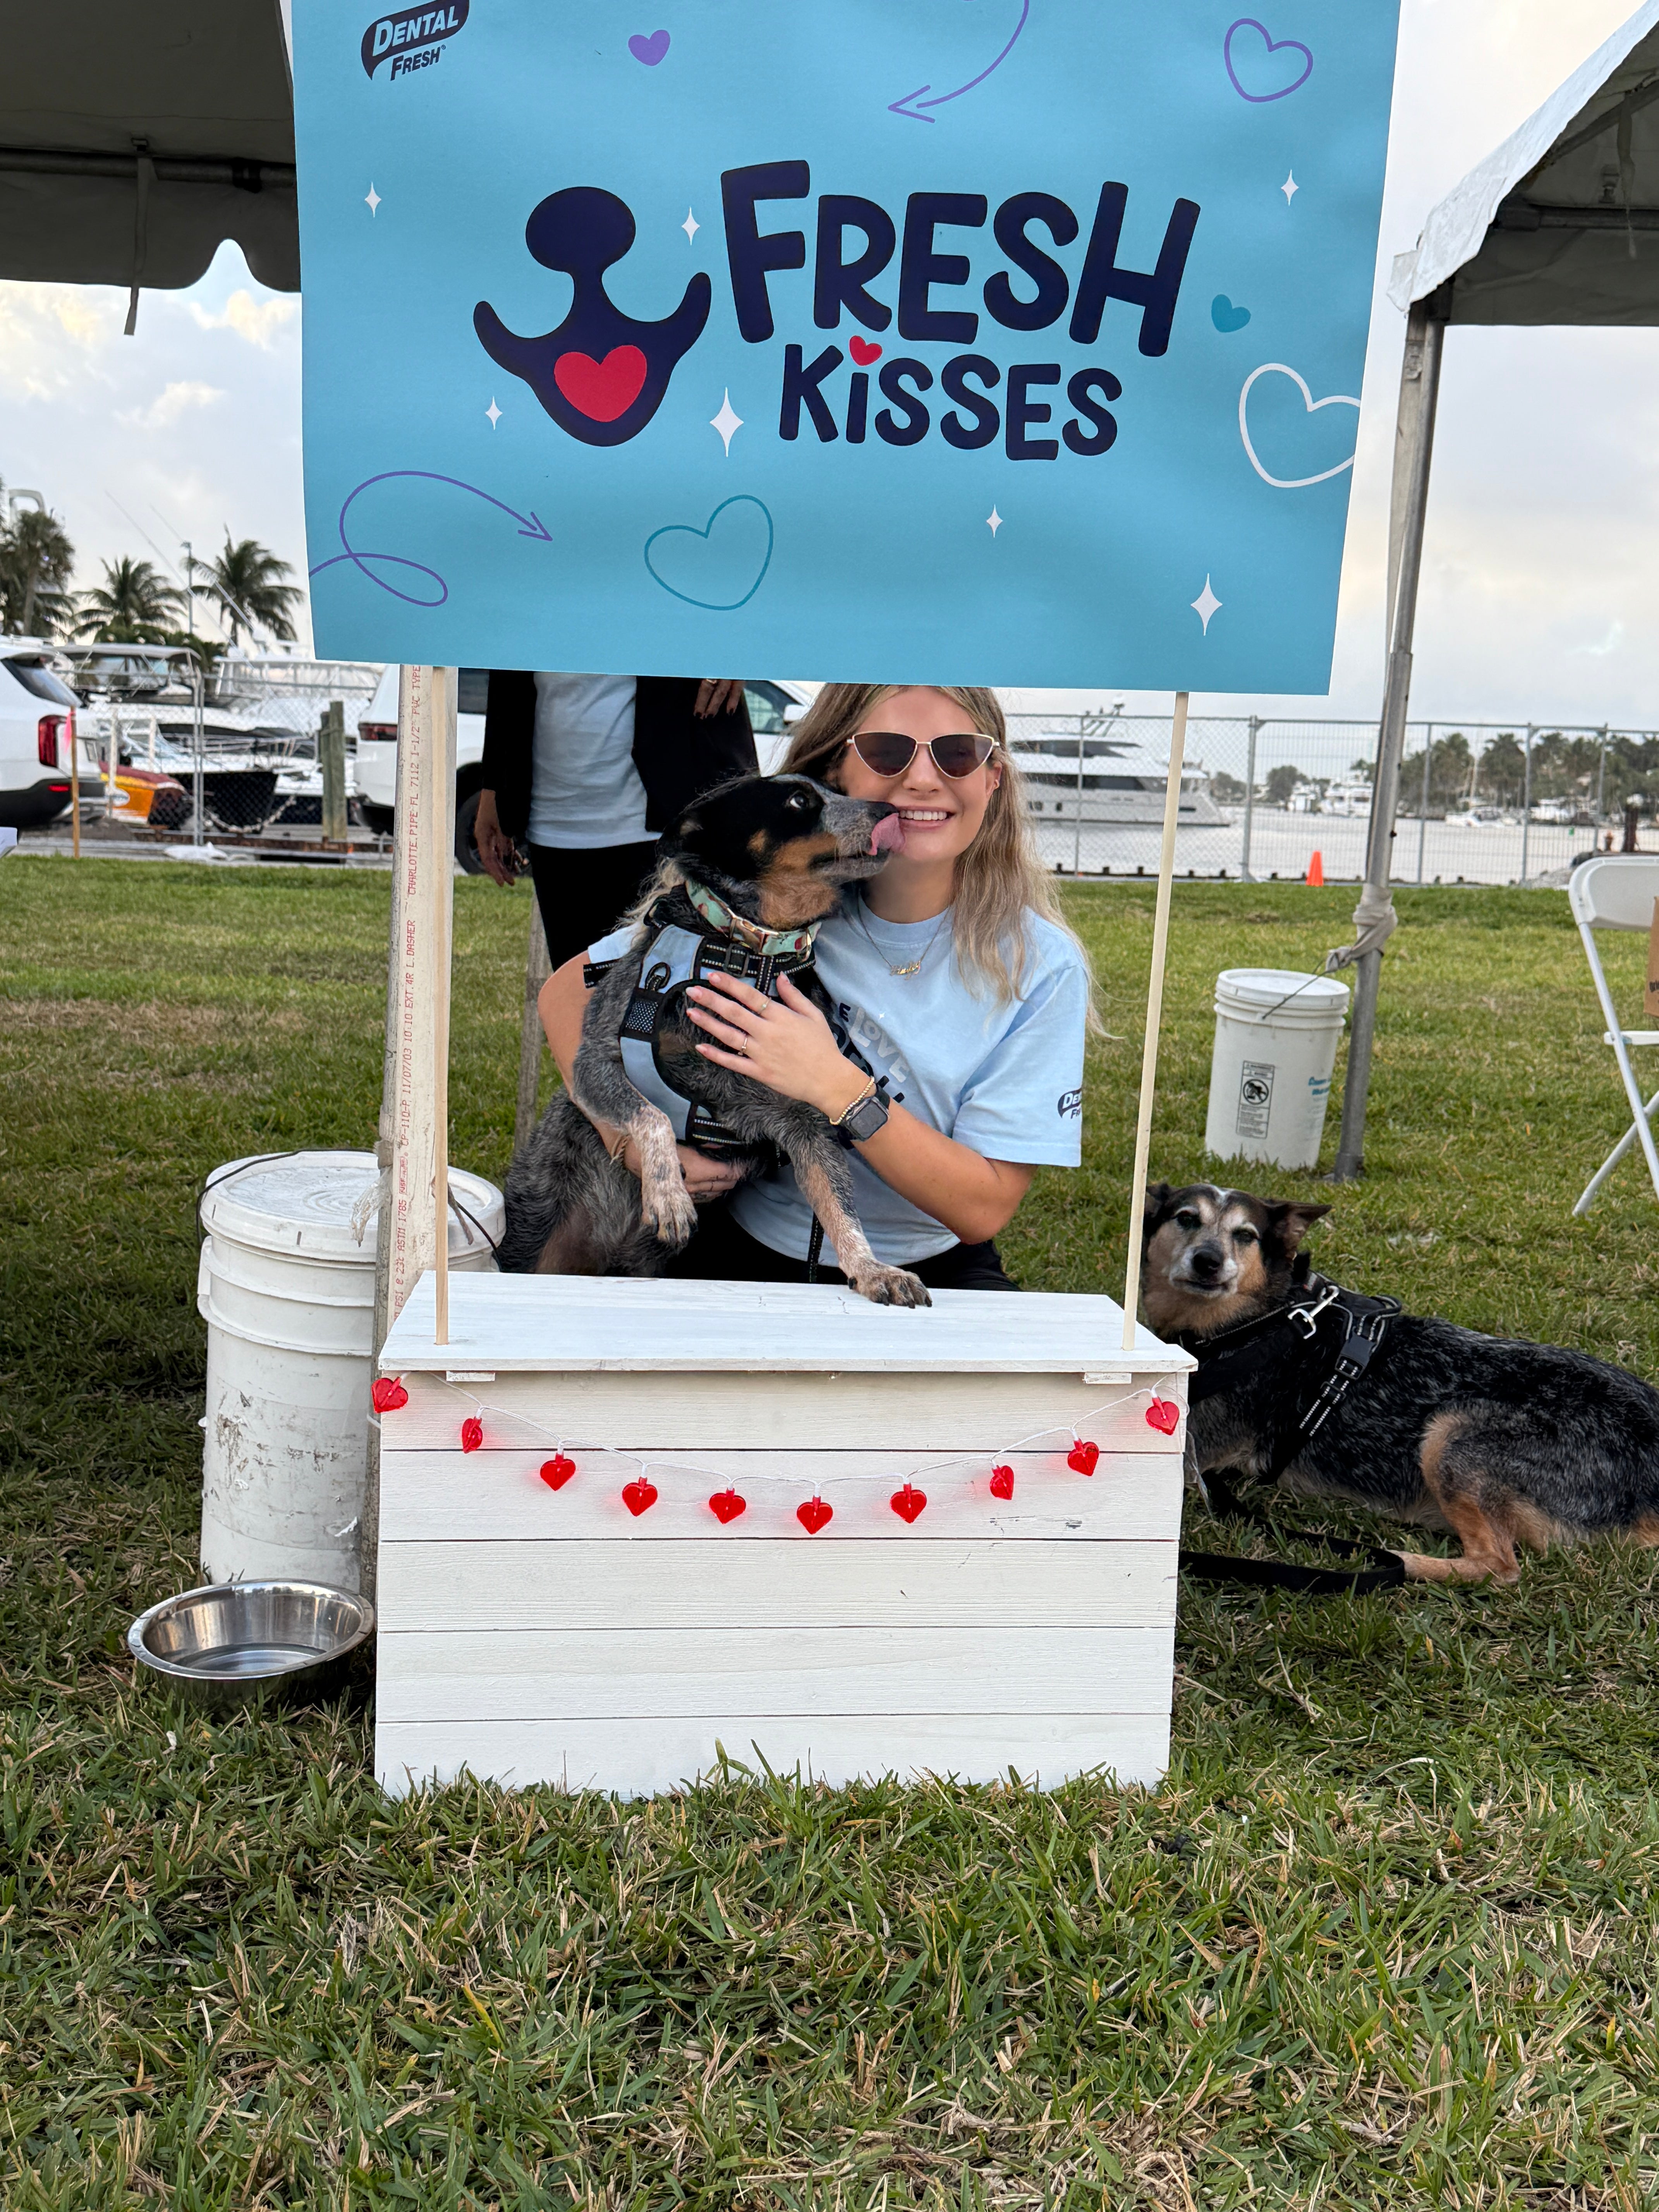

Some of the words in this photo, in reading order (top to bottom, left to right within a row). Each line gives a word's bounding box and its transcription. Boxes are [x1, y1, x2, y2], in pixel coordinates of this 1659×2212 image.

[372, 5, 459, 57] DENTAL
[721, 160, 1200, 357] FRESH
[412, 666, 421, 690] TYPE
[412, 696, 421, 715] PVC
[410, 763, 419, 787] 7112
[410, 793, 419, 806] FL
[848, 1006, 910, 1083] LOVE
[402, 1048, 412, 1094] 11/07/03
[398, 1199, 407, 1222] 1785
[397, 1228, 406, 1252] ASTM
[395, 1291, 404, 1307] PSI
